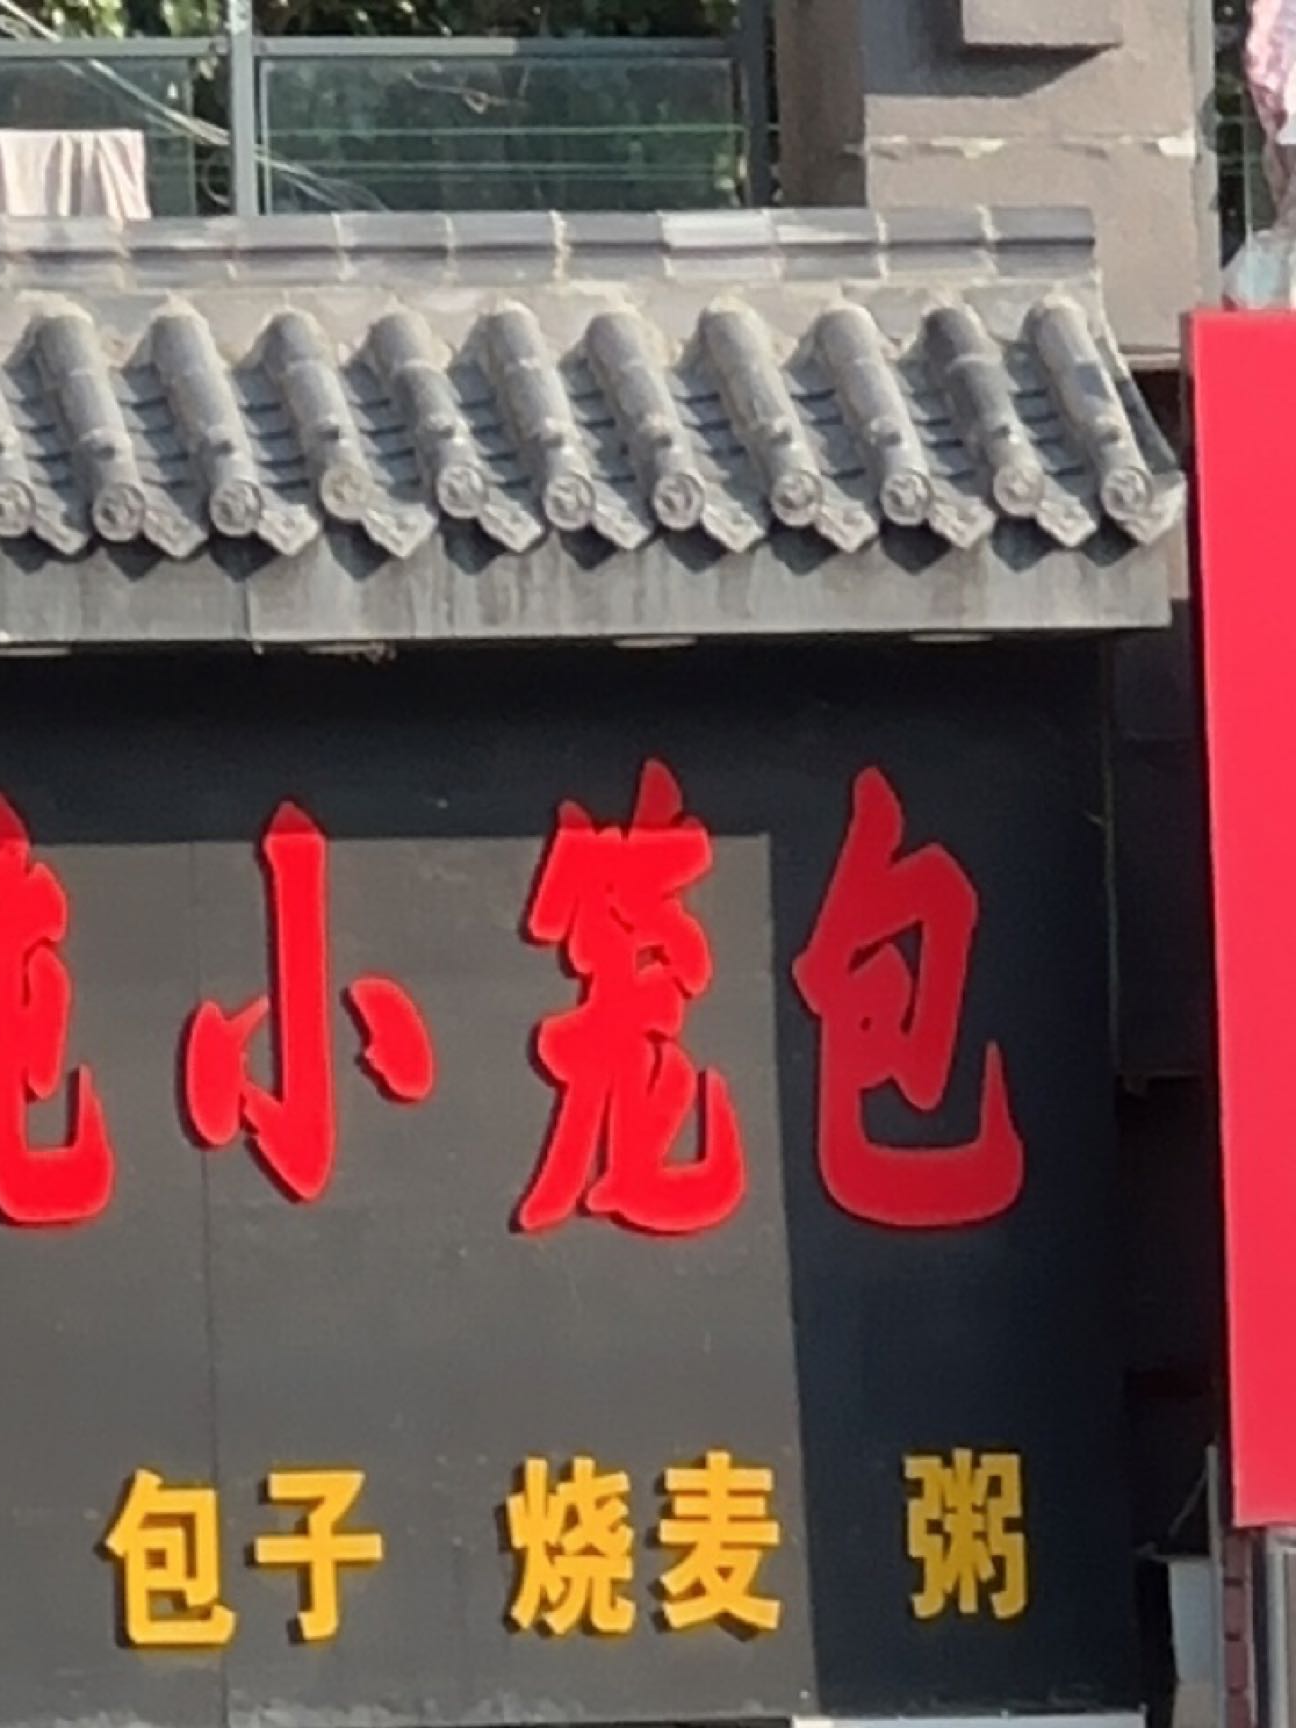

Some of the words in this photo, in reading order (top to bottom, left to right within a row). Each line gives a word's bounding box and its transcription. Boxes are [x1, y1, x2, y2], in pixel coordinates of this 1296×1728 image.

[106, 1467, 384, 1649] 包子
[507, 1449, 784, 1643] 烧麦
[905, 1449, 1028, 1620] 粥
